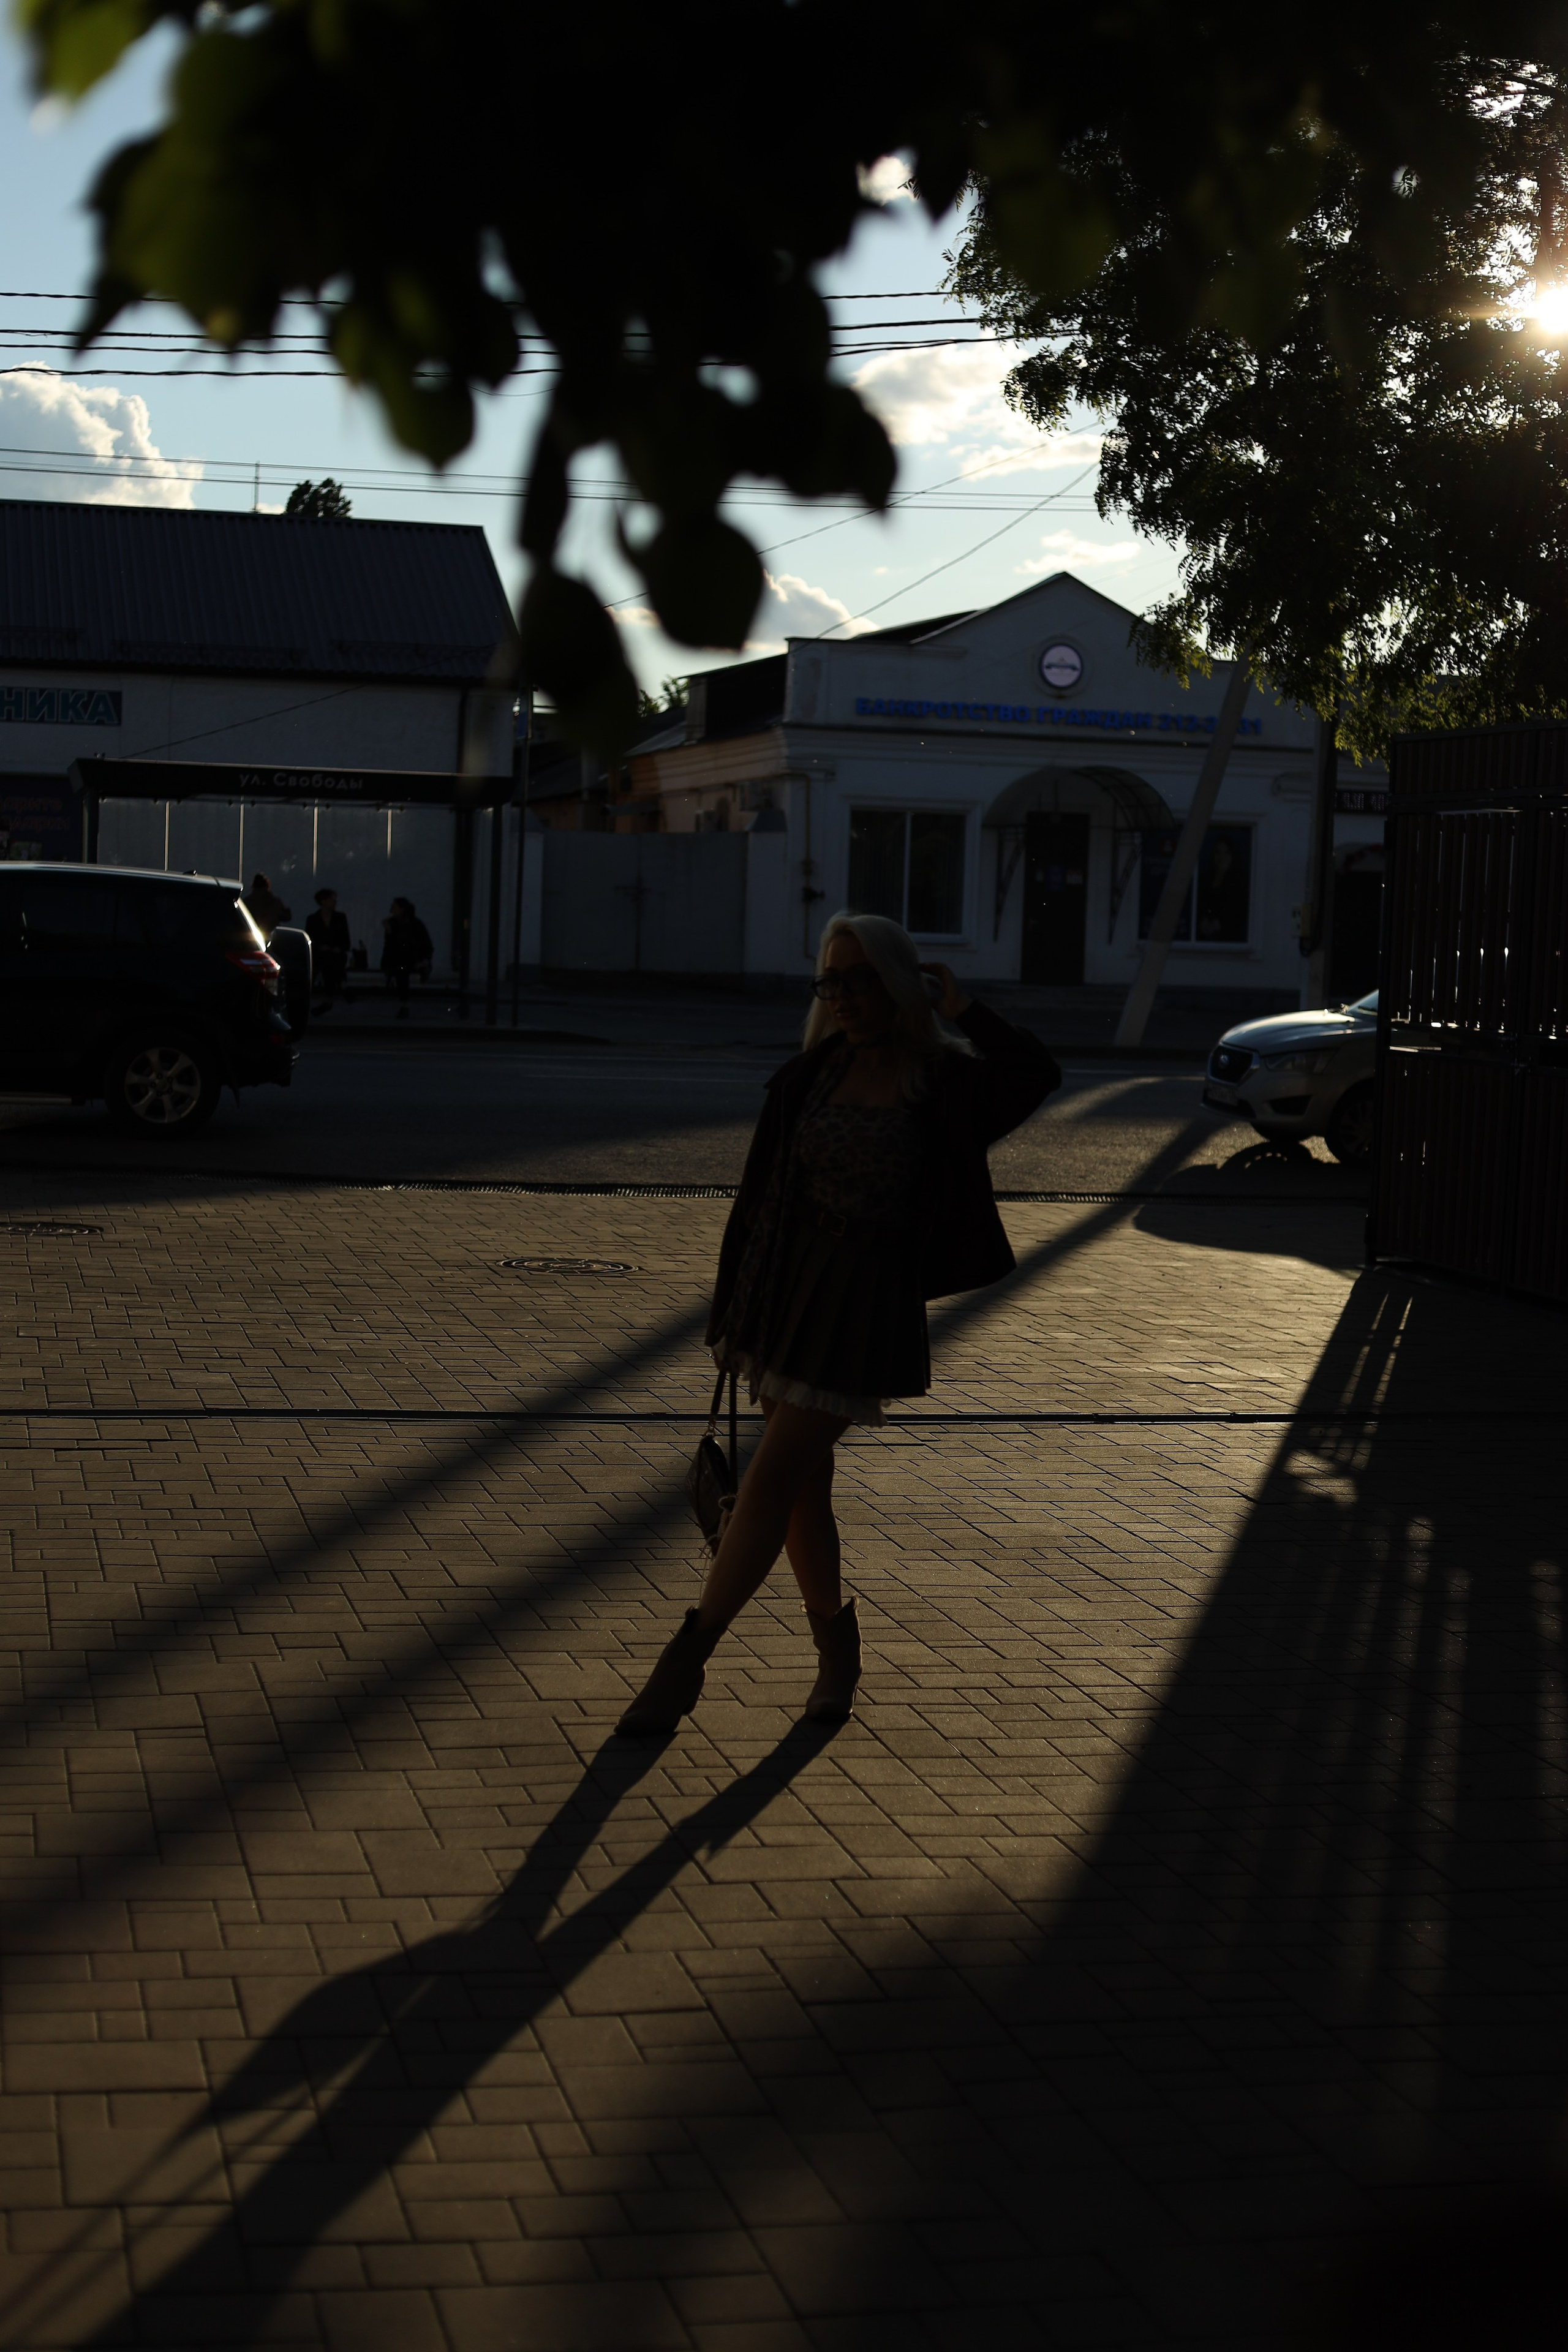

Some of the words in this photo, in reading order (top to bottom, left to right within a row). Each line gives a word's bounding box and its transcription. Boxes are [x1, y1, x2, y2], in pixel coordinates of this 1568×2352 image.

[856, 697, 1030, 723] БАНКРОТСТВО
[1038, 706, 1152, 730] ГРАЖДАН
[239, 772, 266, 788] ул.
[273, 771, 363, 790] Свободы
